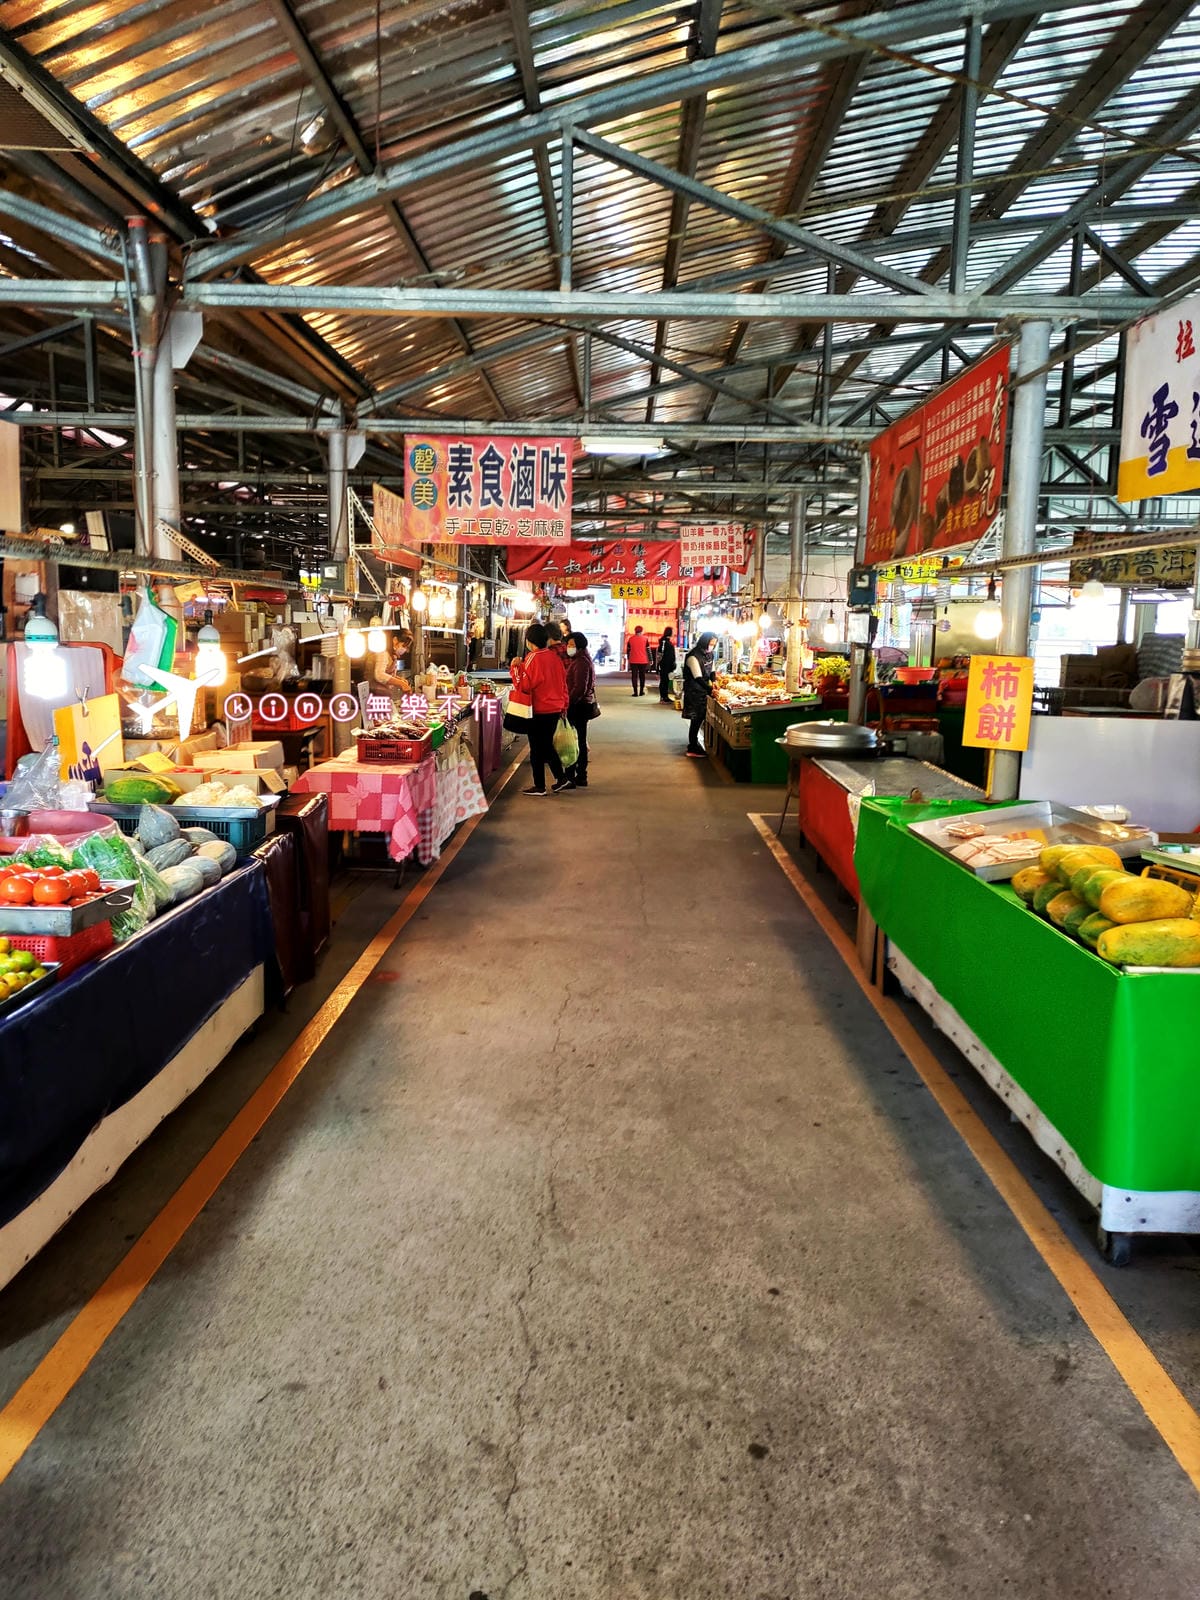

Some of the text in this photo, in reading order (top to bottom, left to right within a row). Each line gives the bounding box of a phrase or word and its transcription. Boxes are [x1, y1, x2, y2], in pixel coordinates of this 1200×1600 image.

[447, 442, 568, 512] 素食滷味
[976, 660, 1022, 743] 柿餅
